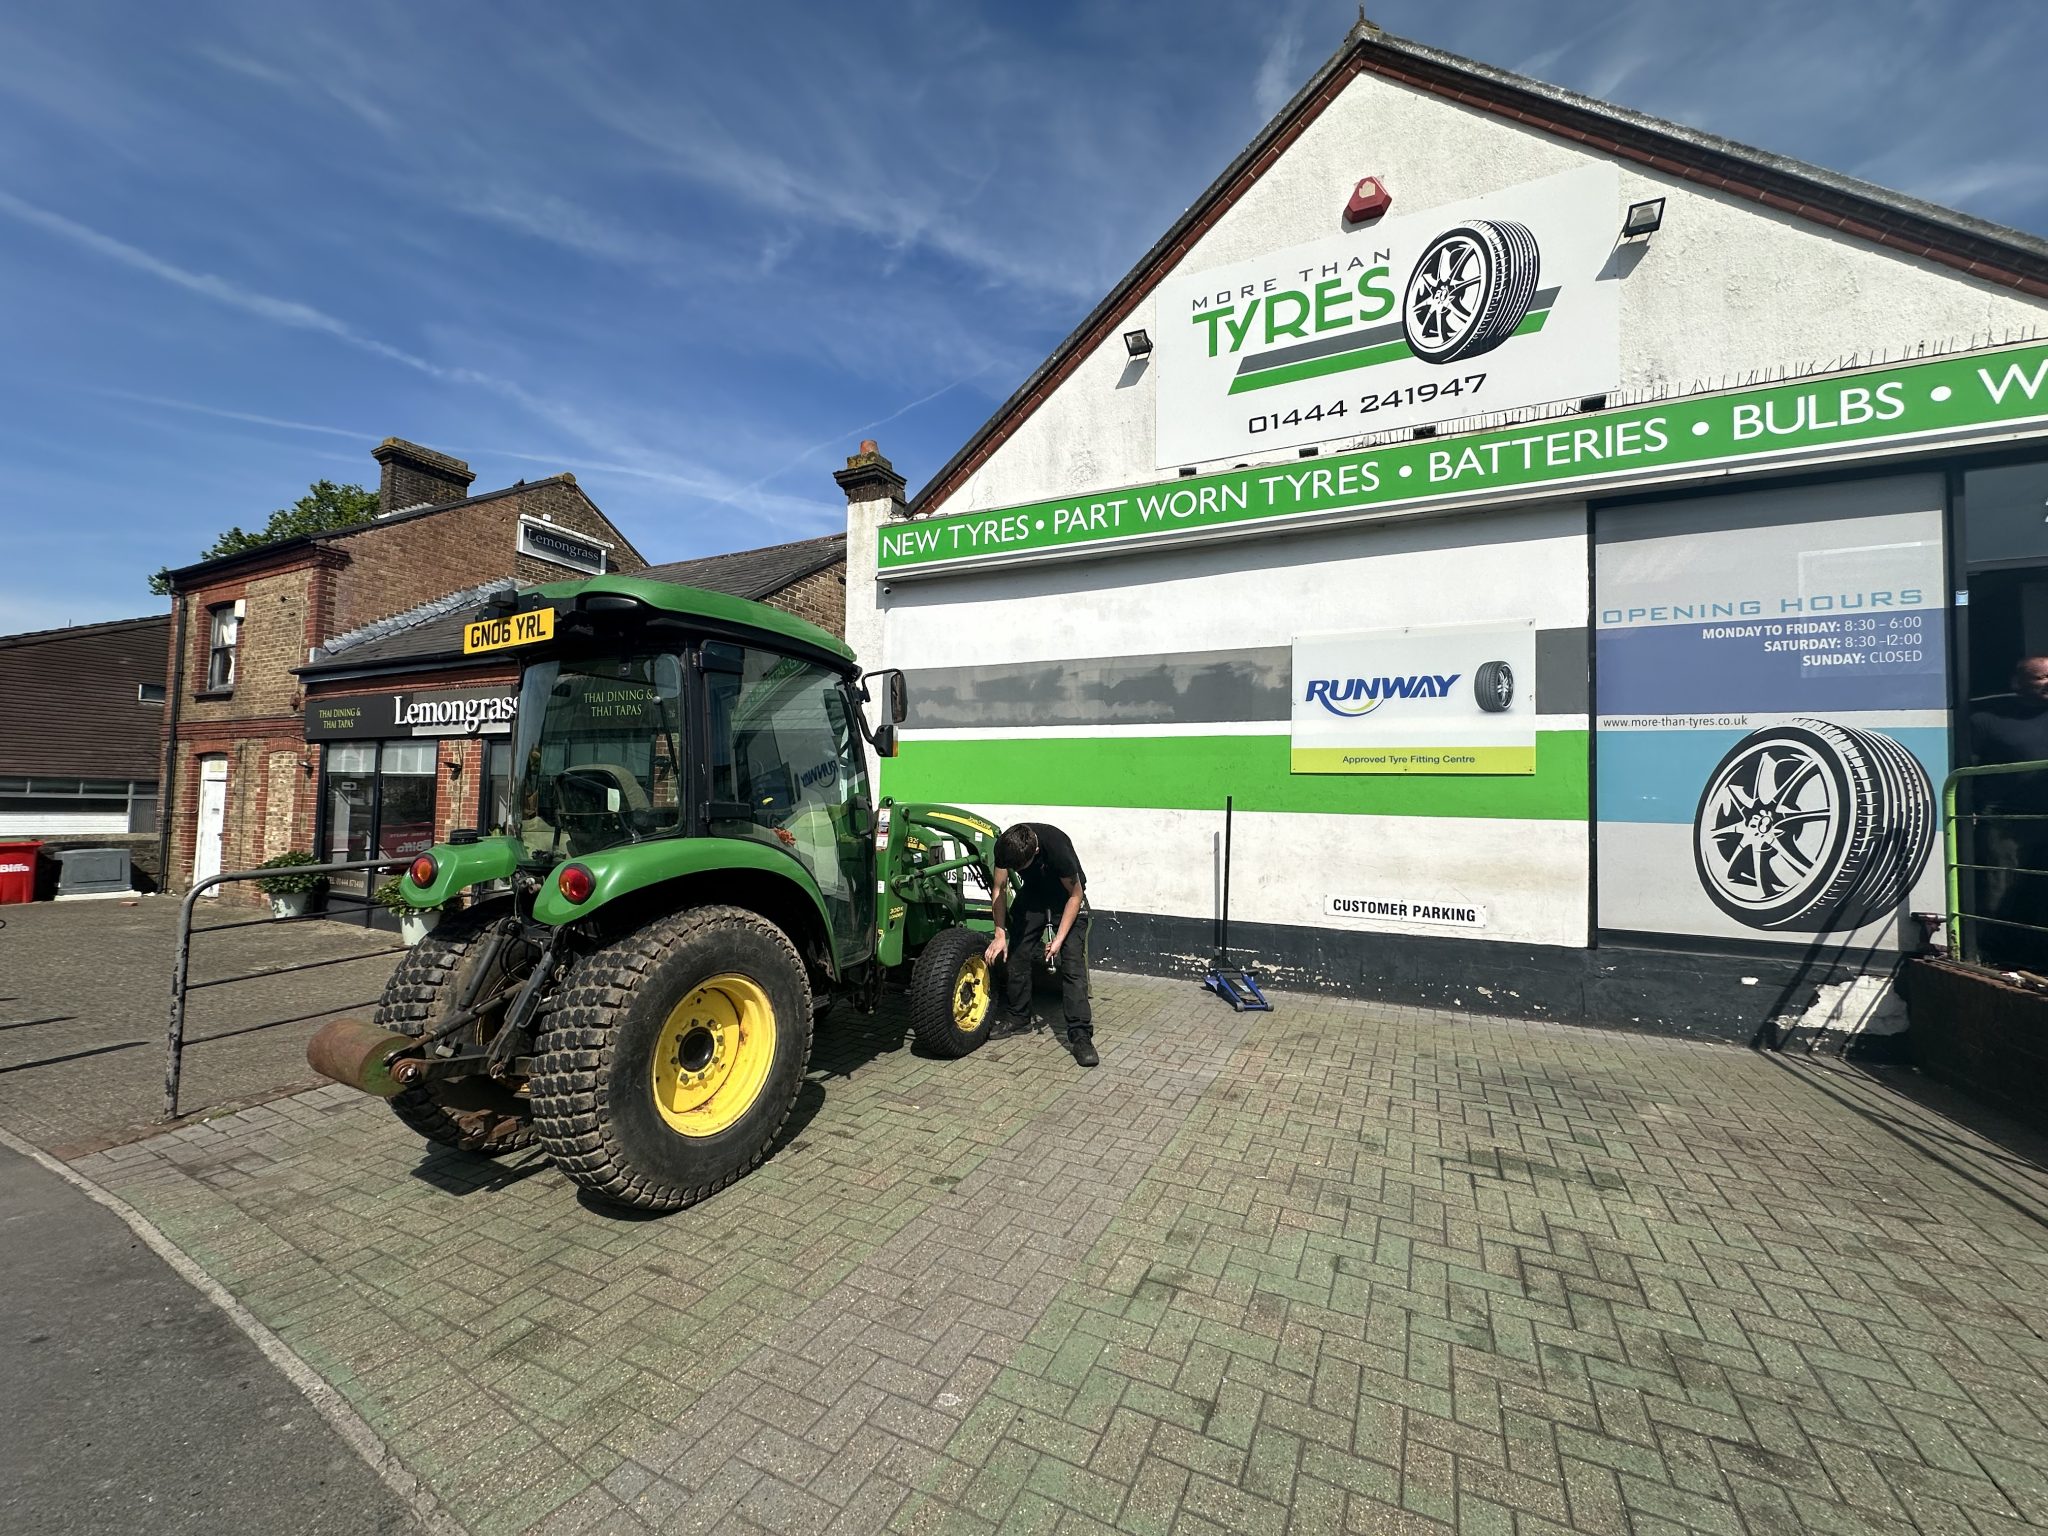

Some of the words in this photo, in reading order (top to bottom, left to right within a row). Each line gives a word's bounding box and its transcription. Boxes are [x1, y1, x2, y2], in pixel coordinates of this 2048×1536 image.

[1192, 278, 1278, 311] MORE
[1299, 247, 1392, 282] THAN
[1248, 400, 1349, 435] 01444
[1360, 373, 1488, 414] 241947
[883, 526, 941, 559] NEW
[948, 515, 1030, 550] TYRES
[1054, 499, 1128, 535] PART
[1138, 482, 1248, 521] WORN
[1260, 461, 1381, 502] TYRES
[1429, 418, 1668, 483] BATTERIES
[1733, 382, 1905, 441] BULBS
[527, 528, 599, 560] Lemongrass
[1603, 600, 1761, 624] OPENING
[1781, 589, 1923, 613] HOURS
[470, 620, 512, 648] GN06
[516, 613, 546, 640] YRL
[1703, 624, 1762, 639] MONDAY
[1762, 624, 1782, 636] TO
[1786, 620, 1841, 635] FRIDAY:
[1844, 619, 1876, 631] 8:30
[1889, 616, 1922, 629] 6:00
[1764, 637, 1841, 652] SATURDAY:
[1845, 635, 1876, 648] 8:30
[1803, 652, 1866, 667] SUNDAY:
[1870, 650, 1923, 664] CLOSED
[584, 692, 604, 703] THAI
[607, 689, 644, 702] DINING
[646, 688, 654, 700] &
[1305, 673, 1462, 708] RUNWAY
[319, 709, 332, 718] THAI
[334, 708, 355, 717] DINING
[591, 705, 612, 717] THAI
[615, 704, 642, 716] TAPAS
[1603, 715, 1748, 728] www.more-than-tyres.co.uk
[1342, 755, 1386, 764] Approved
[1389, 755, 1408, 764] Tyre
[1410, 755, 1440, 764] Fitting
[1442, 755, 1475, 763] Centre
[1333, 898, 1408, 917] CUSTOMER
[1413, 905, 1476, 922] PARKING
